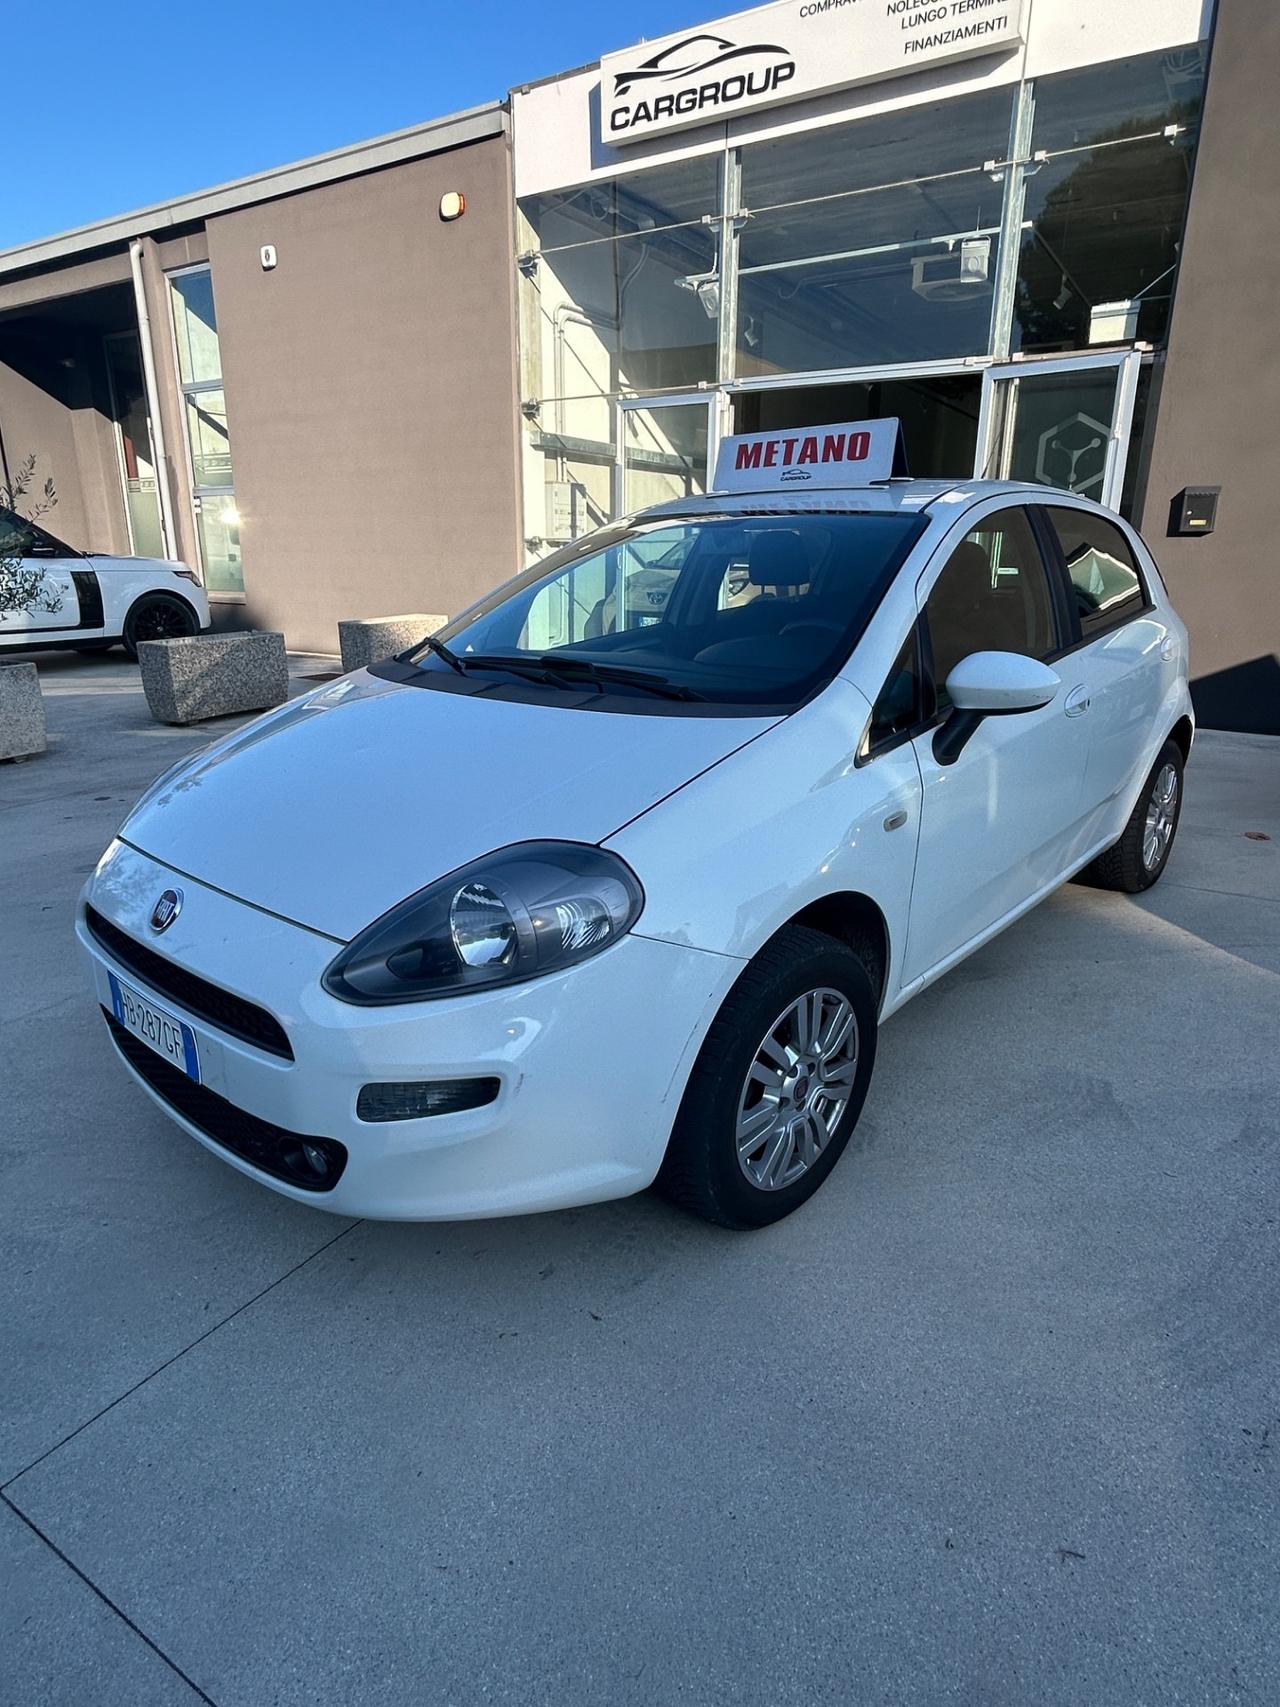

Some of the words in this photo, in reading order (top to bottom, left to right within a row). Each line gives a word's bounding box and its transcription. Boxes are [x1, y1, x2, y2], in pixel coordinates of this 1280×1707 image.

[799, 0, 857, 18] COMPR
[887, 0, 938, 16] NOLE
[901, 6, 947, 30] LUNGO
[950, 0, 1008, 16] TERM
[904, 15, 1008, 54] FINANZIAMENTI
[610, 61, 795, 131] CARGROUP
[735, 431, 871, 470] METANO
